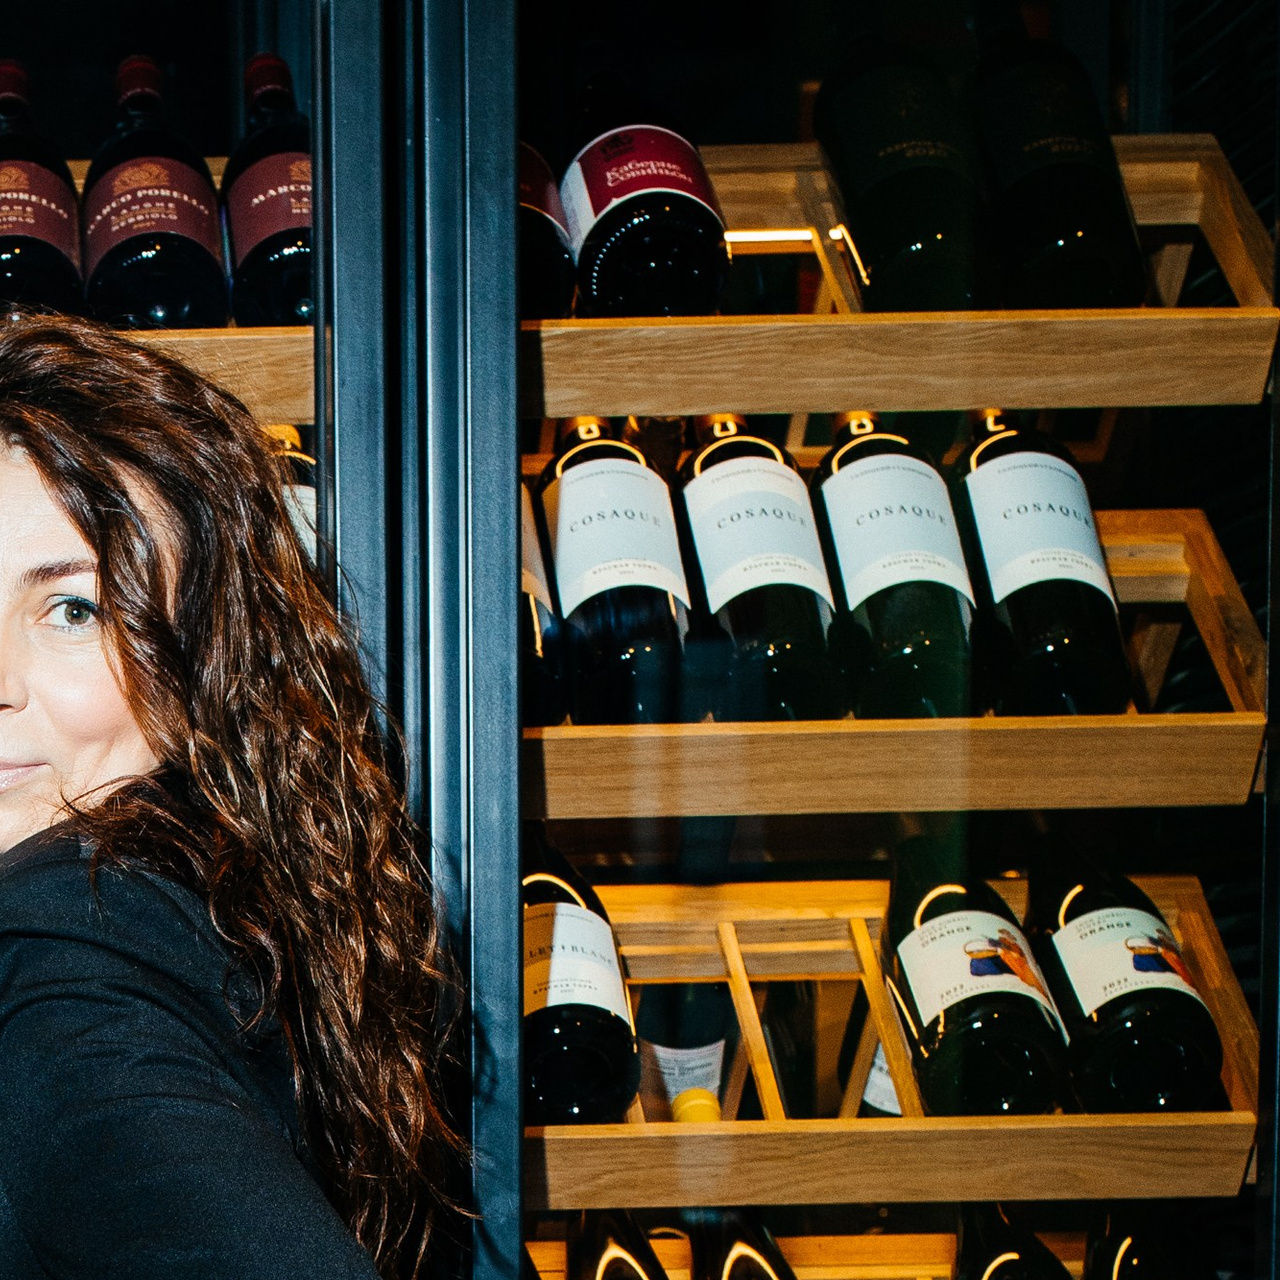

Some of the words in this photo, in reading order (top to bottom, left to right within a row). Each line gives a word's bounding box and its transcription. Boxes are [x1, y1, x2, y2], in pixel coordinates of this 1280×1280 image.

[251, 184, 312, 208] MARCO
[569, 507, 661, 534] COSAQUE
[716, 506, 807, 531] COSAQUE
[855, 503, 948, 528] COSAQUE
[1002, 501, 1093, 530] COSAQUE
[921, 925, 972, 948] ORANGE
[1079, 920, 1132, 941] ORANGE
